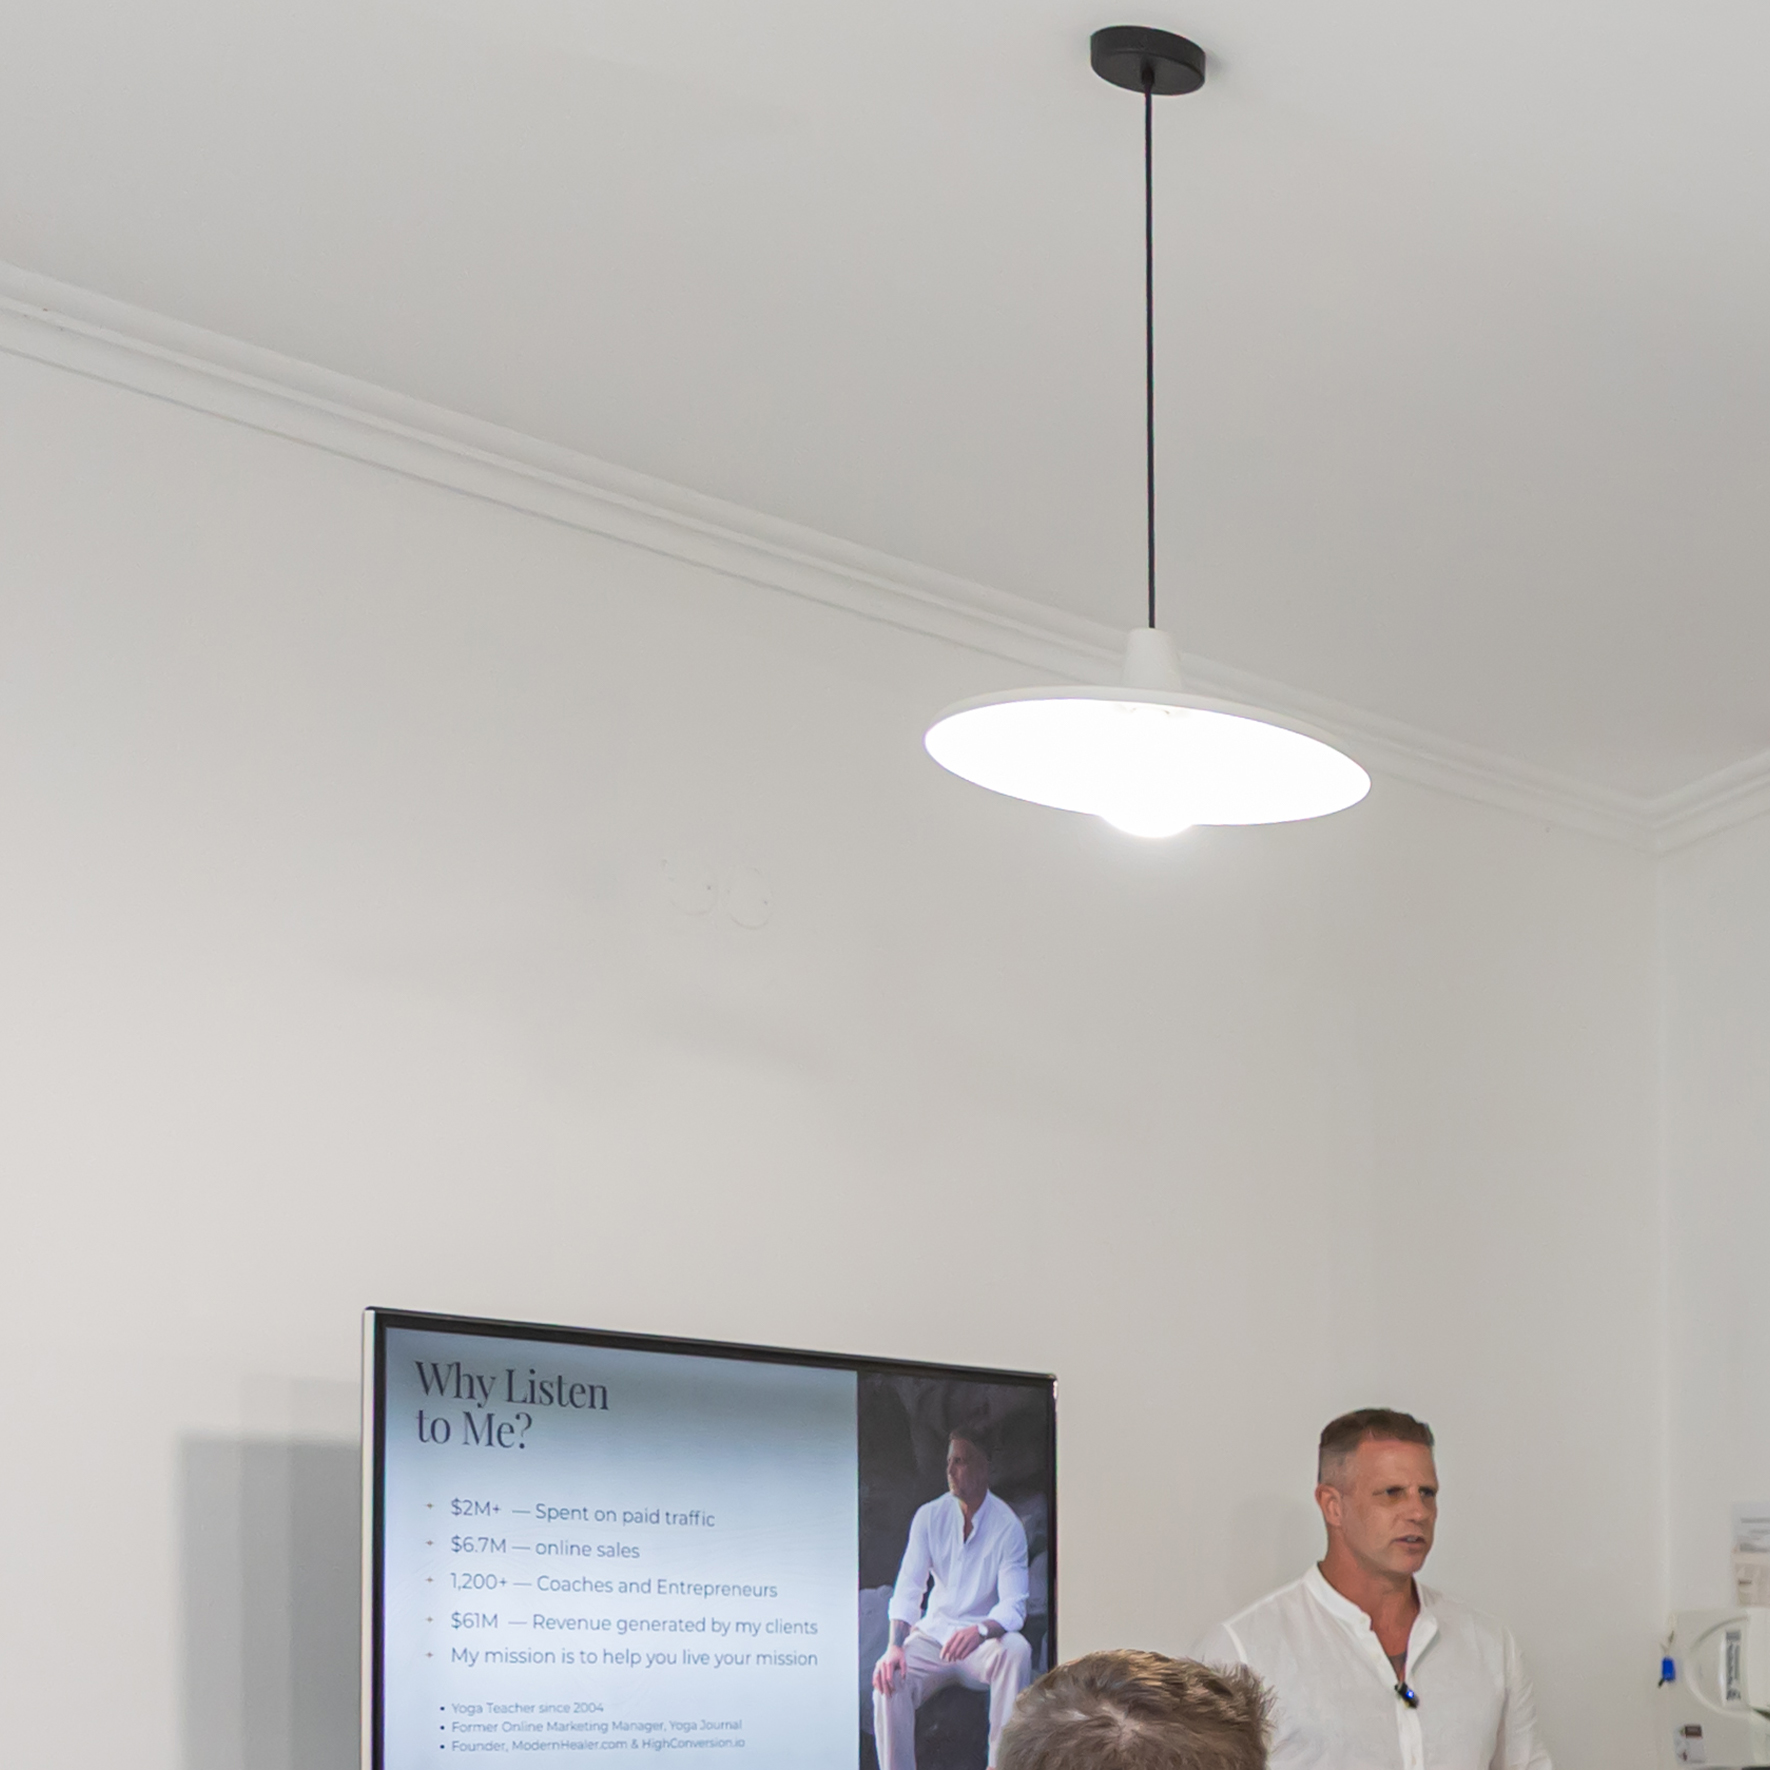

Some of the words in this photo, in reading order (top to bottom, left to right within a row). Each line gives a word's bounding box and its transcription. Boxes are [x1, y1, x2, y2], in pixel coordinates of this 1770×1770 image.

[415, 1361, 497, 1408] Why
[505, 1368, 609, 1411] Listen
[416, 1409, 451, 1444] to
[462, 1411, 533, 1449] Me?
[450, 1497, 502, 1517] $2M+
[535, 1503, 589, 1524] Spent
[594, 1509, 617, 1522] on
[623, 1507, 661, 1527] paid
[665, 1510, 716, 1528] traffic
[450, 1534, 507, 1554] $6.7M
[535, 1539, 592, 1557] online
[597, 1542, 640, 1559] sales
[450, 1572, 508, 1591] 1,200+
[537, 1575, 614, 1593] Coaches
[618, 1577, 651, 1594] and
[657, 1578, 778, 1600] Entrepreneurs
[450, 1610, 499, 1630] $61M
[533, 1613, 612, 1630] Revenue
[616, 1617, 706, 1635] generated
[711, 1617, 731, 1637] by
[735, 1620, 762, 1637] my
[765, 1618, 818, 1635] clients
[450, 1647, 480, 1667] My
[485, 1647, 556, 1664] mission
[562, 1647, 575, 1664] is
[579, 1650, 598, 1664] to
[603, 1648, 642, 1668] help
[645, 1652, 677, 1669] you
[682, 1649, 710, 1665] live
[713, 1652, 752, 1669] your
[756, 1650, 819, 1666] mission
[451, 1703, 483, 1717] Yoga
[486, 1702, 536, 1714] Teacher
[539, 1703, 571, 1714] since
[573, 1702, 604, 1714] 2004
[451, 1721, 498, 1733] Former
[501, 1720, 544, 1733] Online
[546, 1720, 609, 1734] Marketing
[612, 1720, 667, 1734] Manager,
[668, 1719, 698, 1733] Yoga
[700, 1719, 743, 1731] Journal
[451, 1740, 509, 1753] Founder,
[512, 1739, 628, 1751] ModernHealer.com
[641, 1737, 746, 1752] HighConversion.io
